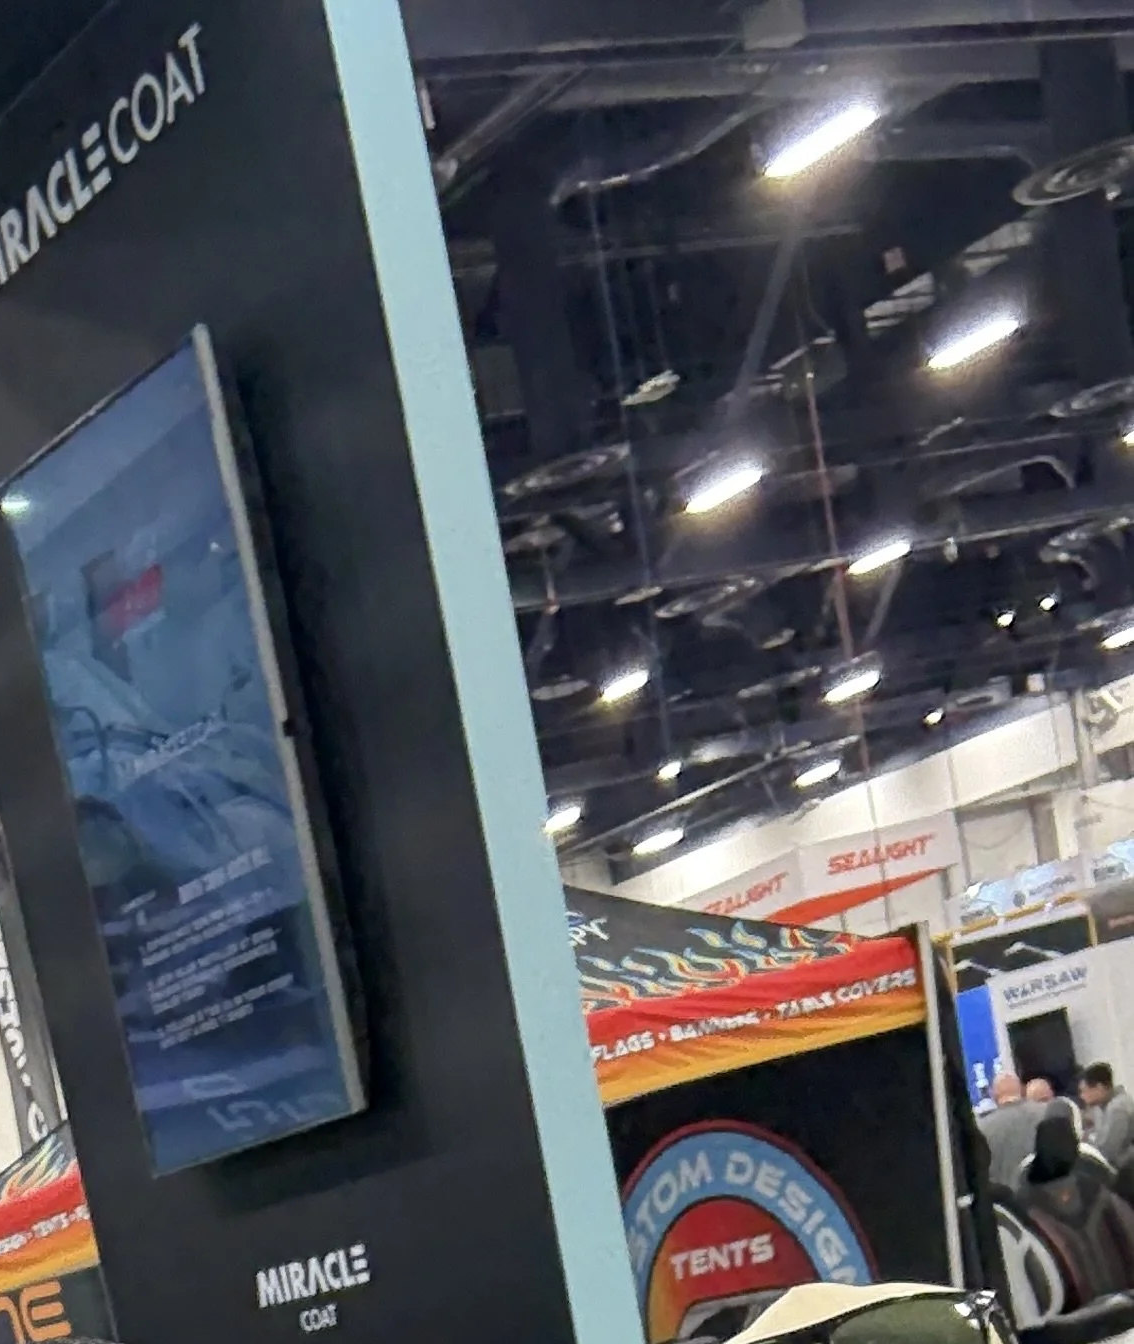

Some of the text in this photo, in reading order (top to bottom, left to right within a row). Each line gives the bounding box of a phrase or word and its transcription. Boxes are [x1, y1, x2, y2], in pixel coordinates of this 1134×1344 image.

[835, 967, 917, 1003] COVERS
[256, 1243, 371, 1308] MIRACLE
[669, 1234, 776, 1280] TENTS
[299, 1304, 338, 1332] COAT
